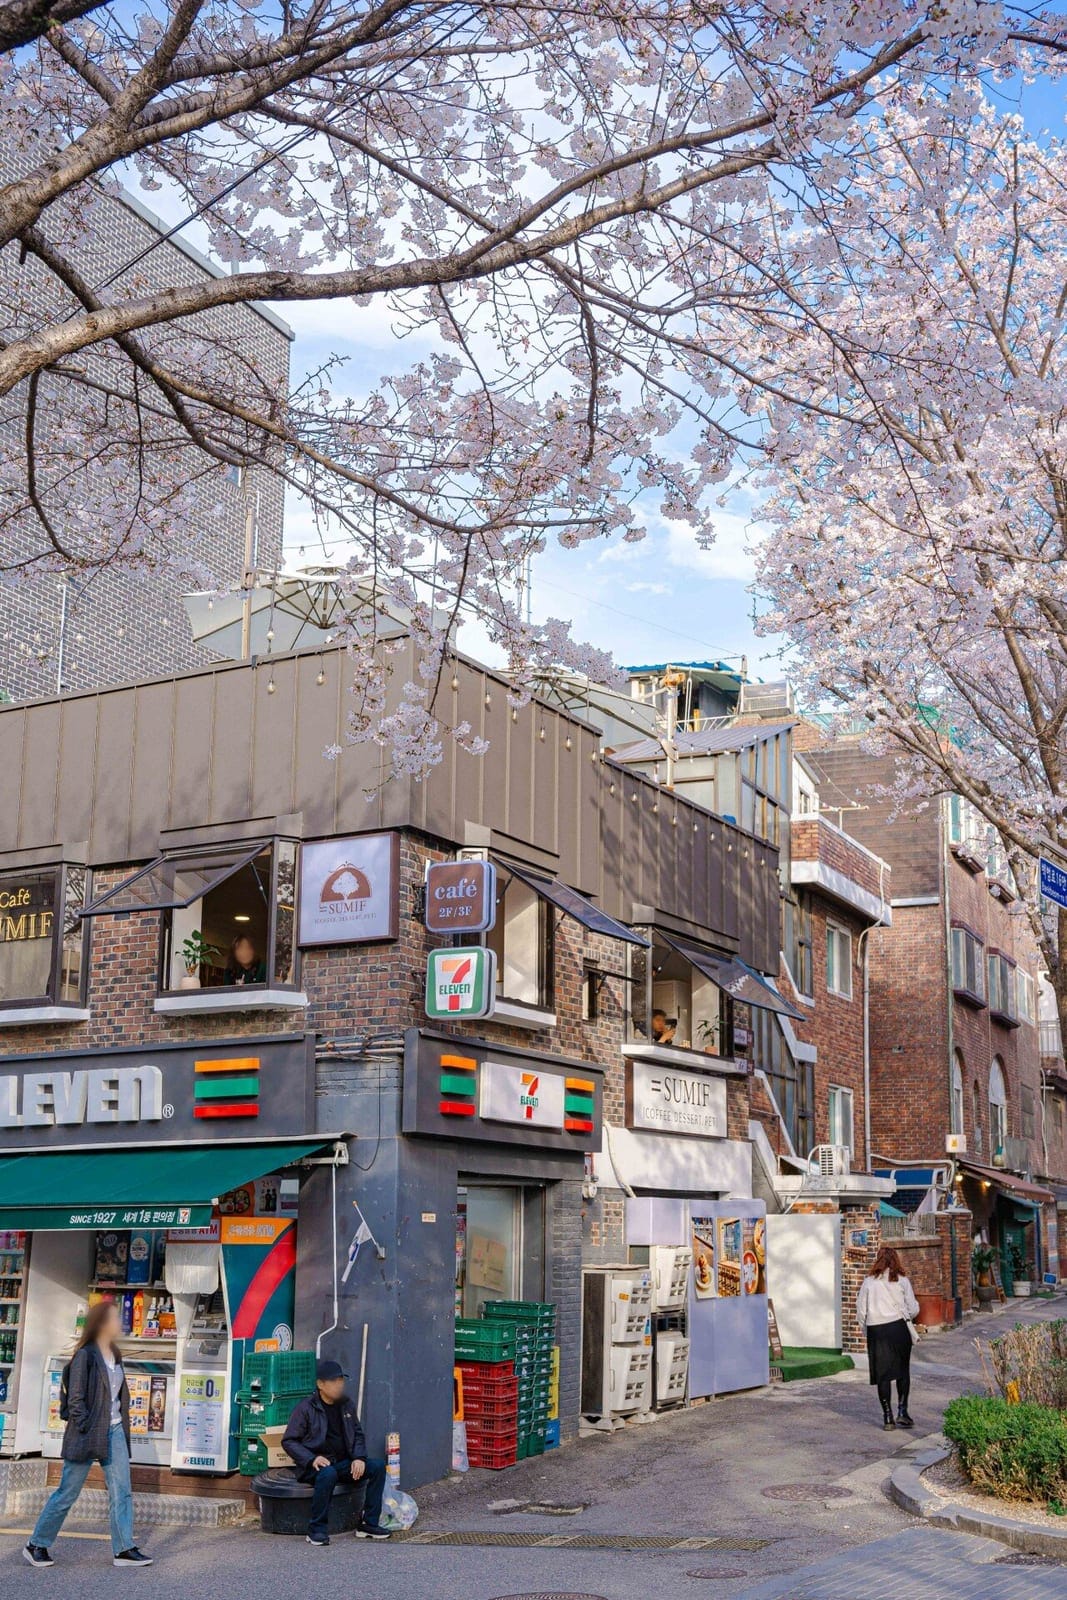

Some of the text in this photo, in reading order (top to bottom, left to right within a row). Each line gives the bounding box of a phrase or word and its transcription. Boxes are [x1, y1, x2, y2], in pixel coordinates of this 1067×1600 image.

[434, 878, 478, 900] café
[0, 888, 31, 908] Café
[439, 905, 473, 918] 2F/3F
[69, 1215, 92, 1224] SINCE
[92, 1212, 117, 1224] 1927
[122, 1211, 139, 1223] 세계
[152, 1211, 176, 1223] 편의점
